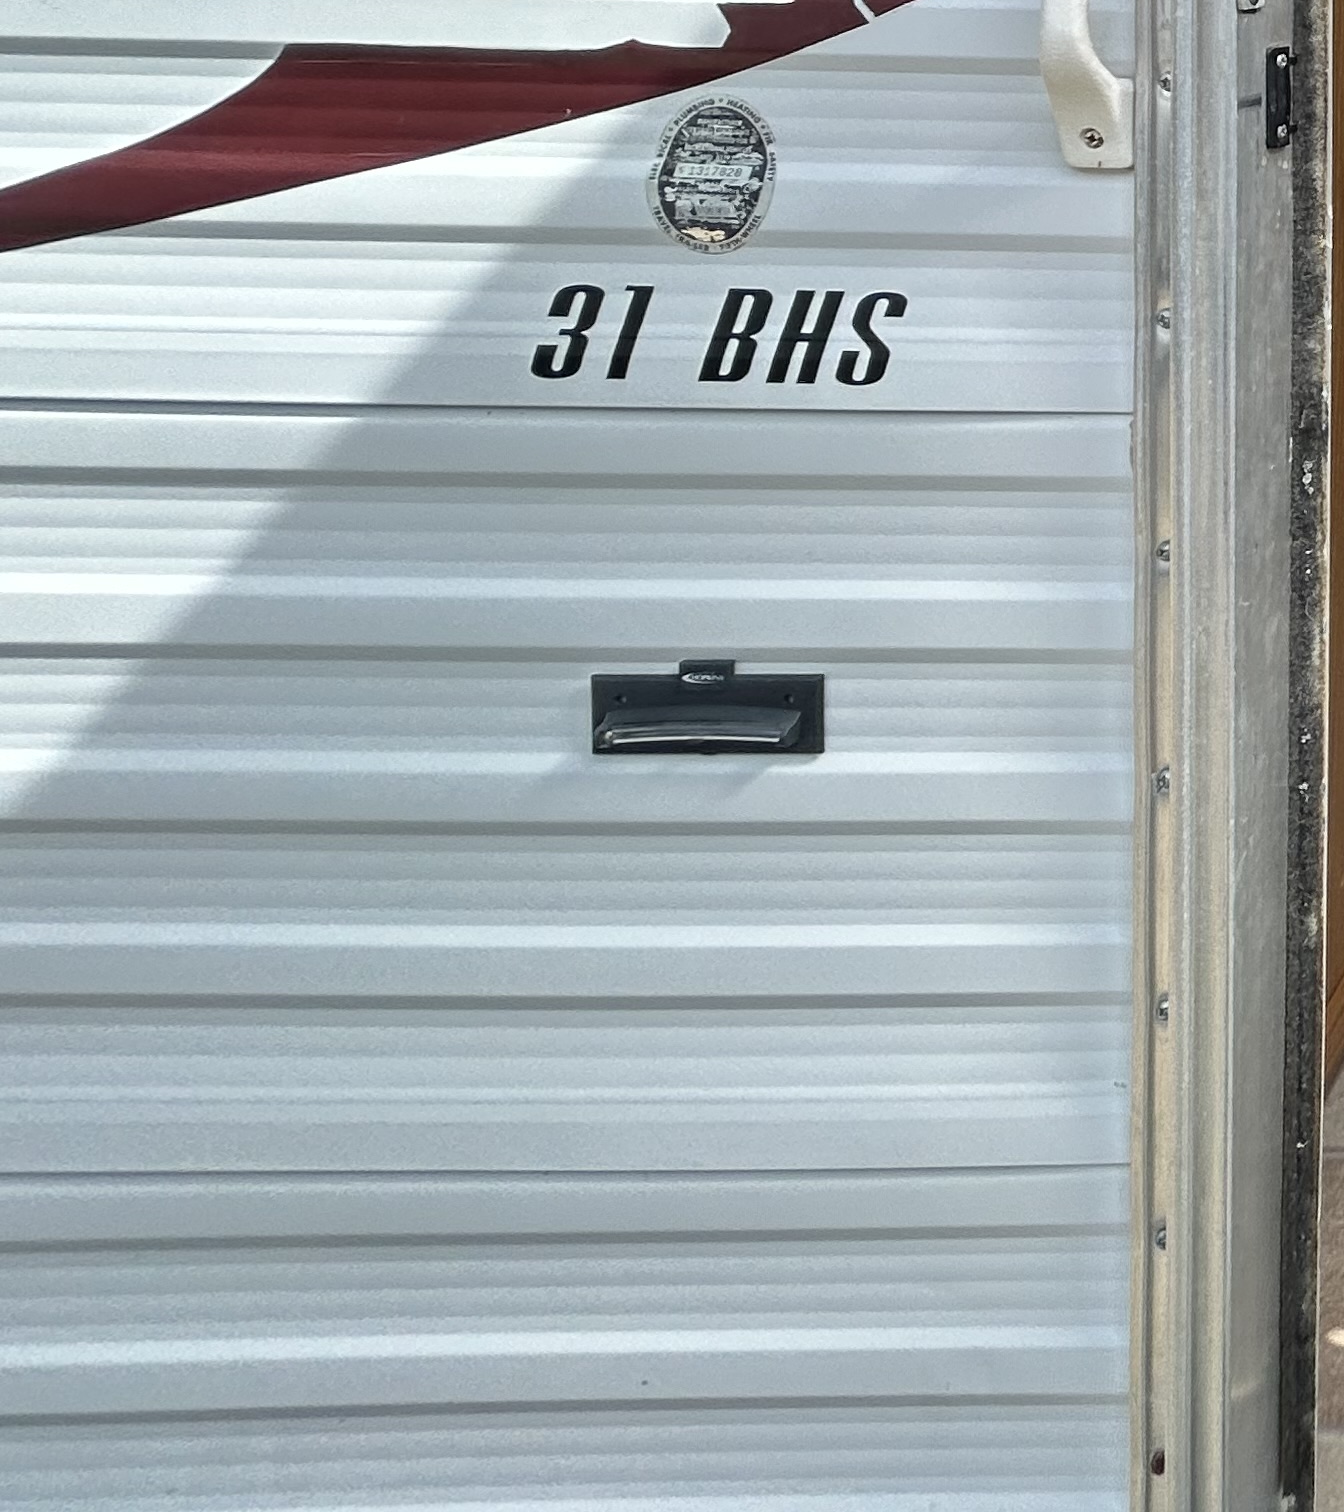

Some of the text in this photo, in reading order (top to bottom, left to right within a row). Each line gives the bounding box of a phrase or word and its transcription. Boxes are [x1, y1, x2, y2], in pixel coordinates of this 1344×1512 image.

[673, 98, 715, 126] PLUMBING
[726, 99, 761, 124] HEATING
[530, 284, 909, 386] 31 BHS
